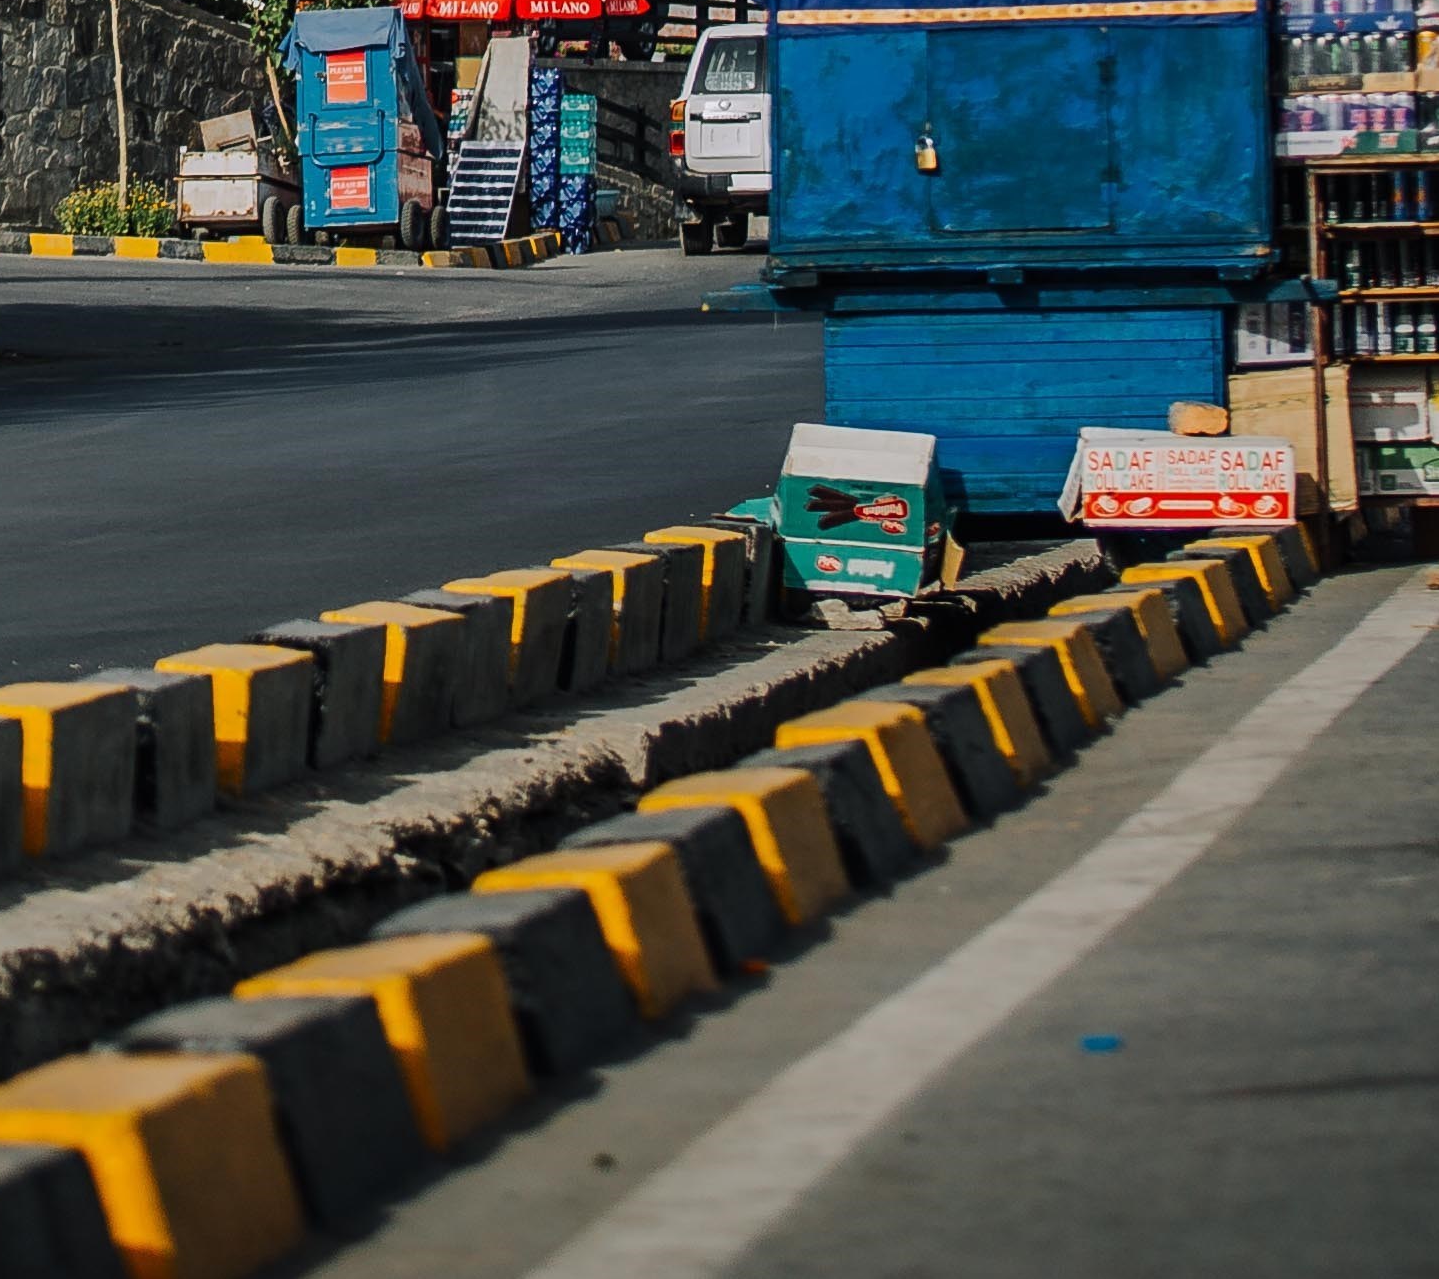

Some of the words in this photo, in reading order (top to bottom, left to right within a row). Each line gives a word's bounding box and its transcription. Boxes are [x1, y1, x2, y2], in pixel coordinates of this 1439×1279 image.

[1087, 450, 1154, 472] SADAF
[1167, 449, 1216, 465] SADAF
[1220, 450, 1286, 472] SADAF
[1087, 473, 1117, 491] ROLL
[1121, 473, 1154, 491] CAKE
[1219, 473, 1251, 491] ROLL
[1252, 473, 1287, 491] CAKE
